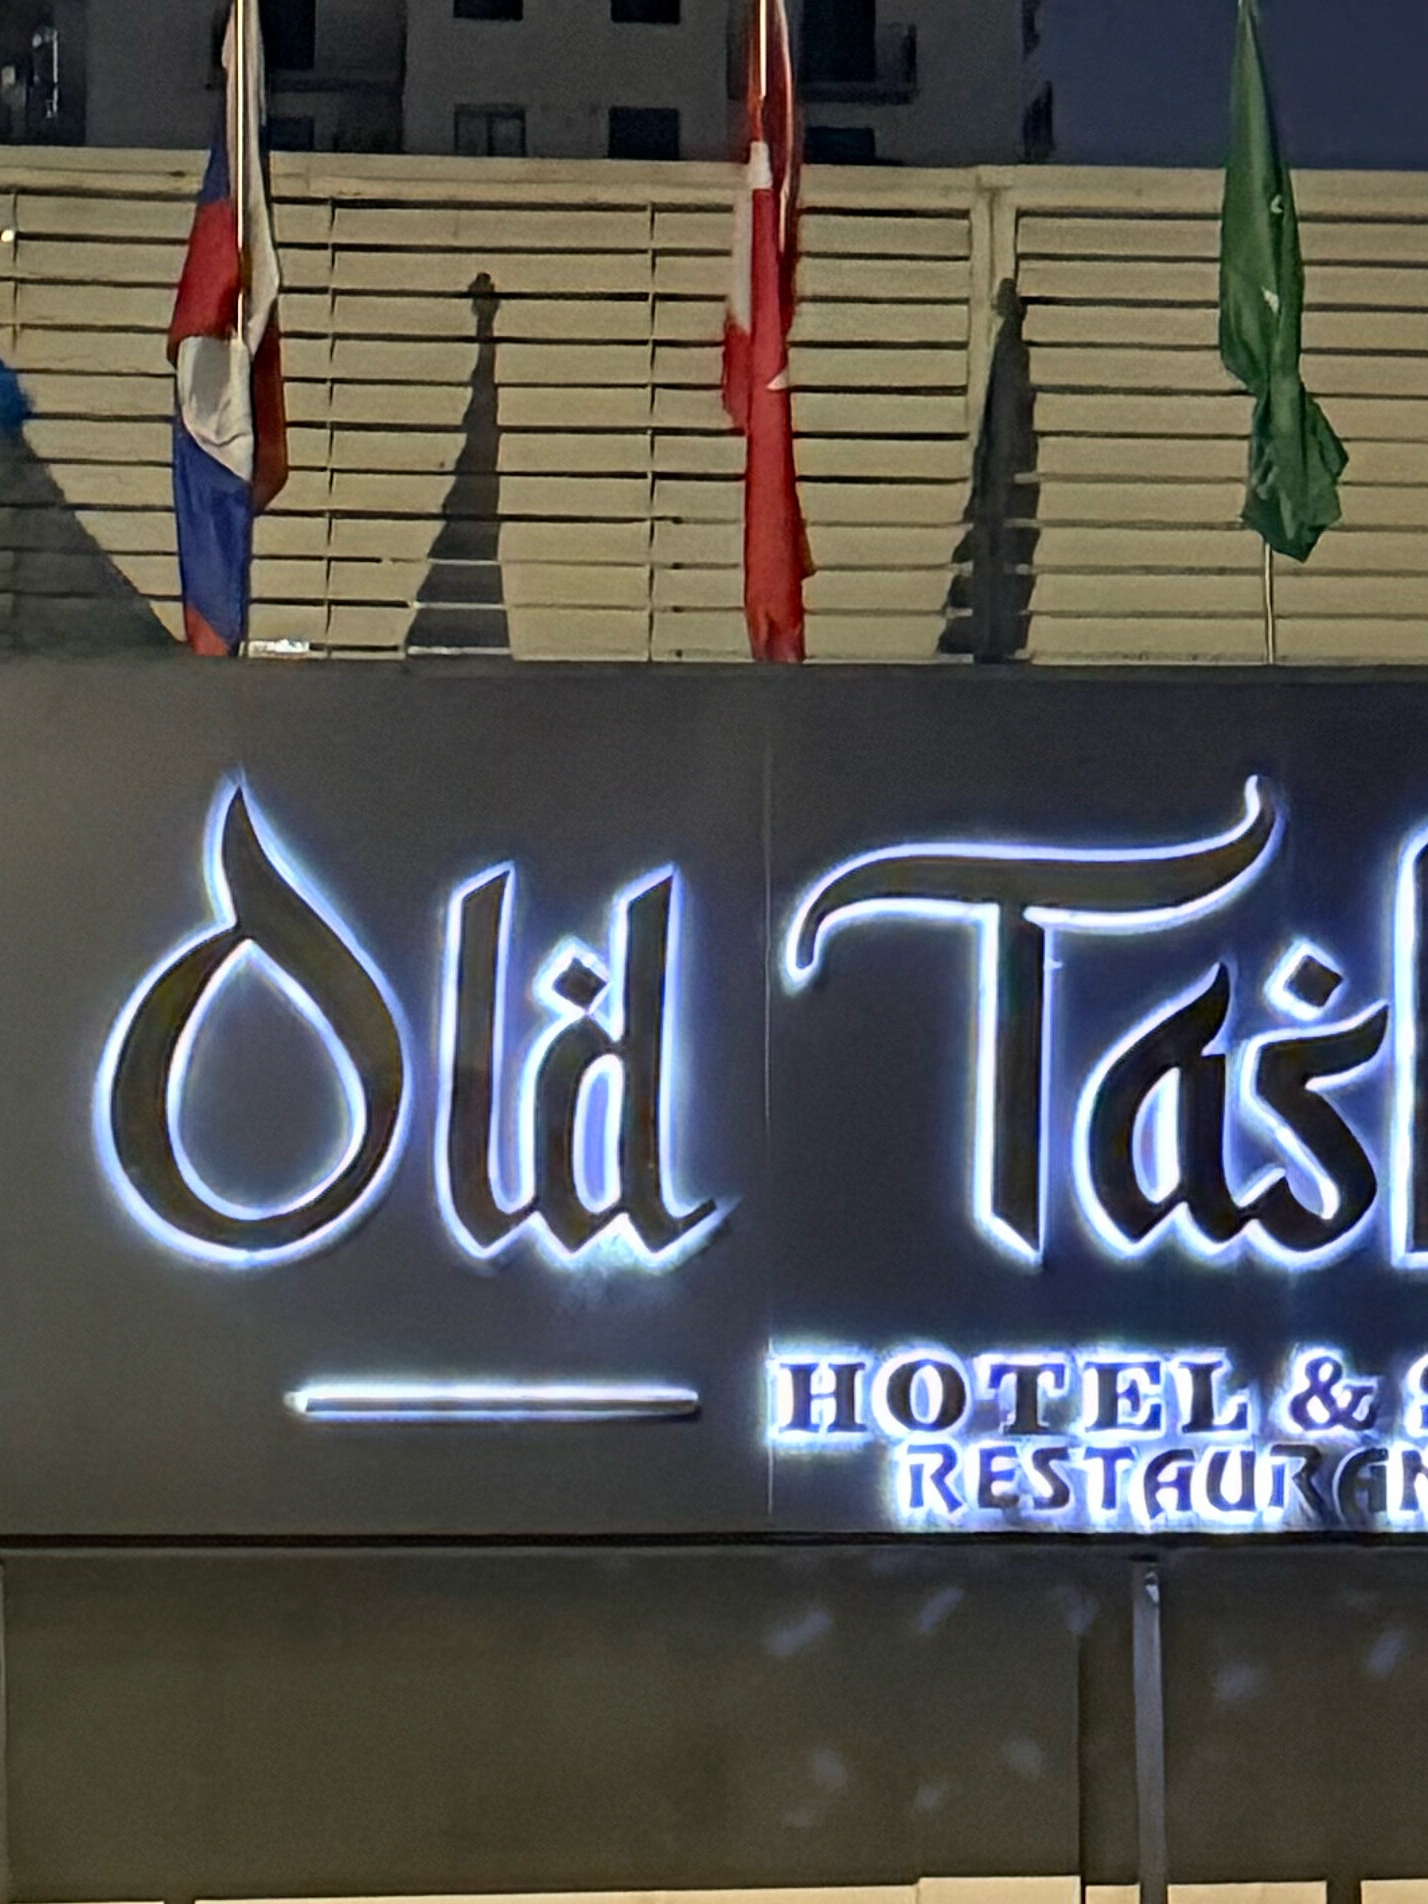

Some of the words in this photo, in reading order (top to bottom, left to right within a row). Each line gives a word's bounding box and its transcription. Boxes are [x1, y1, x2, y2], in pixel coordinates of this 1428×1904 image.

[100, 778, 730, 1264] Old
[775, 1352, 1250, 1438] HOTEL
[1286, 1354, 1374, 1436] &
